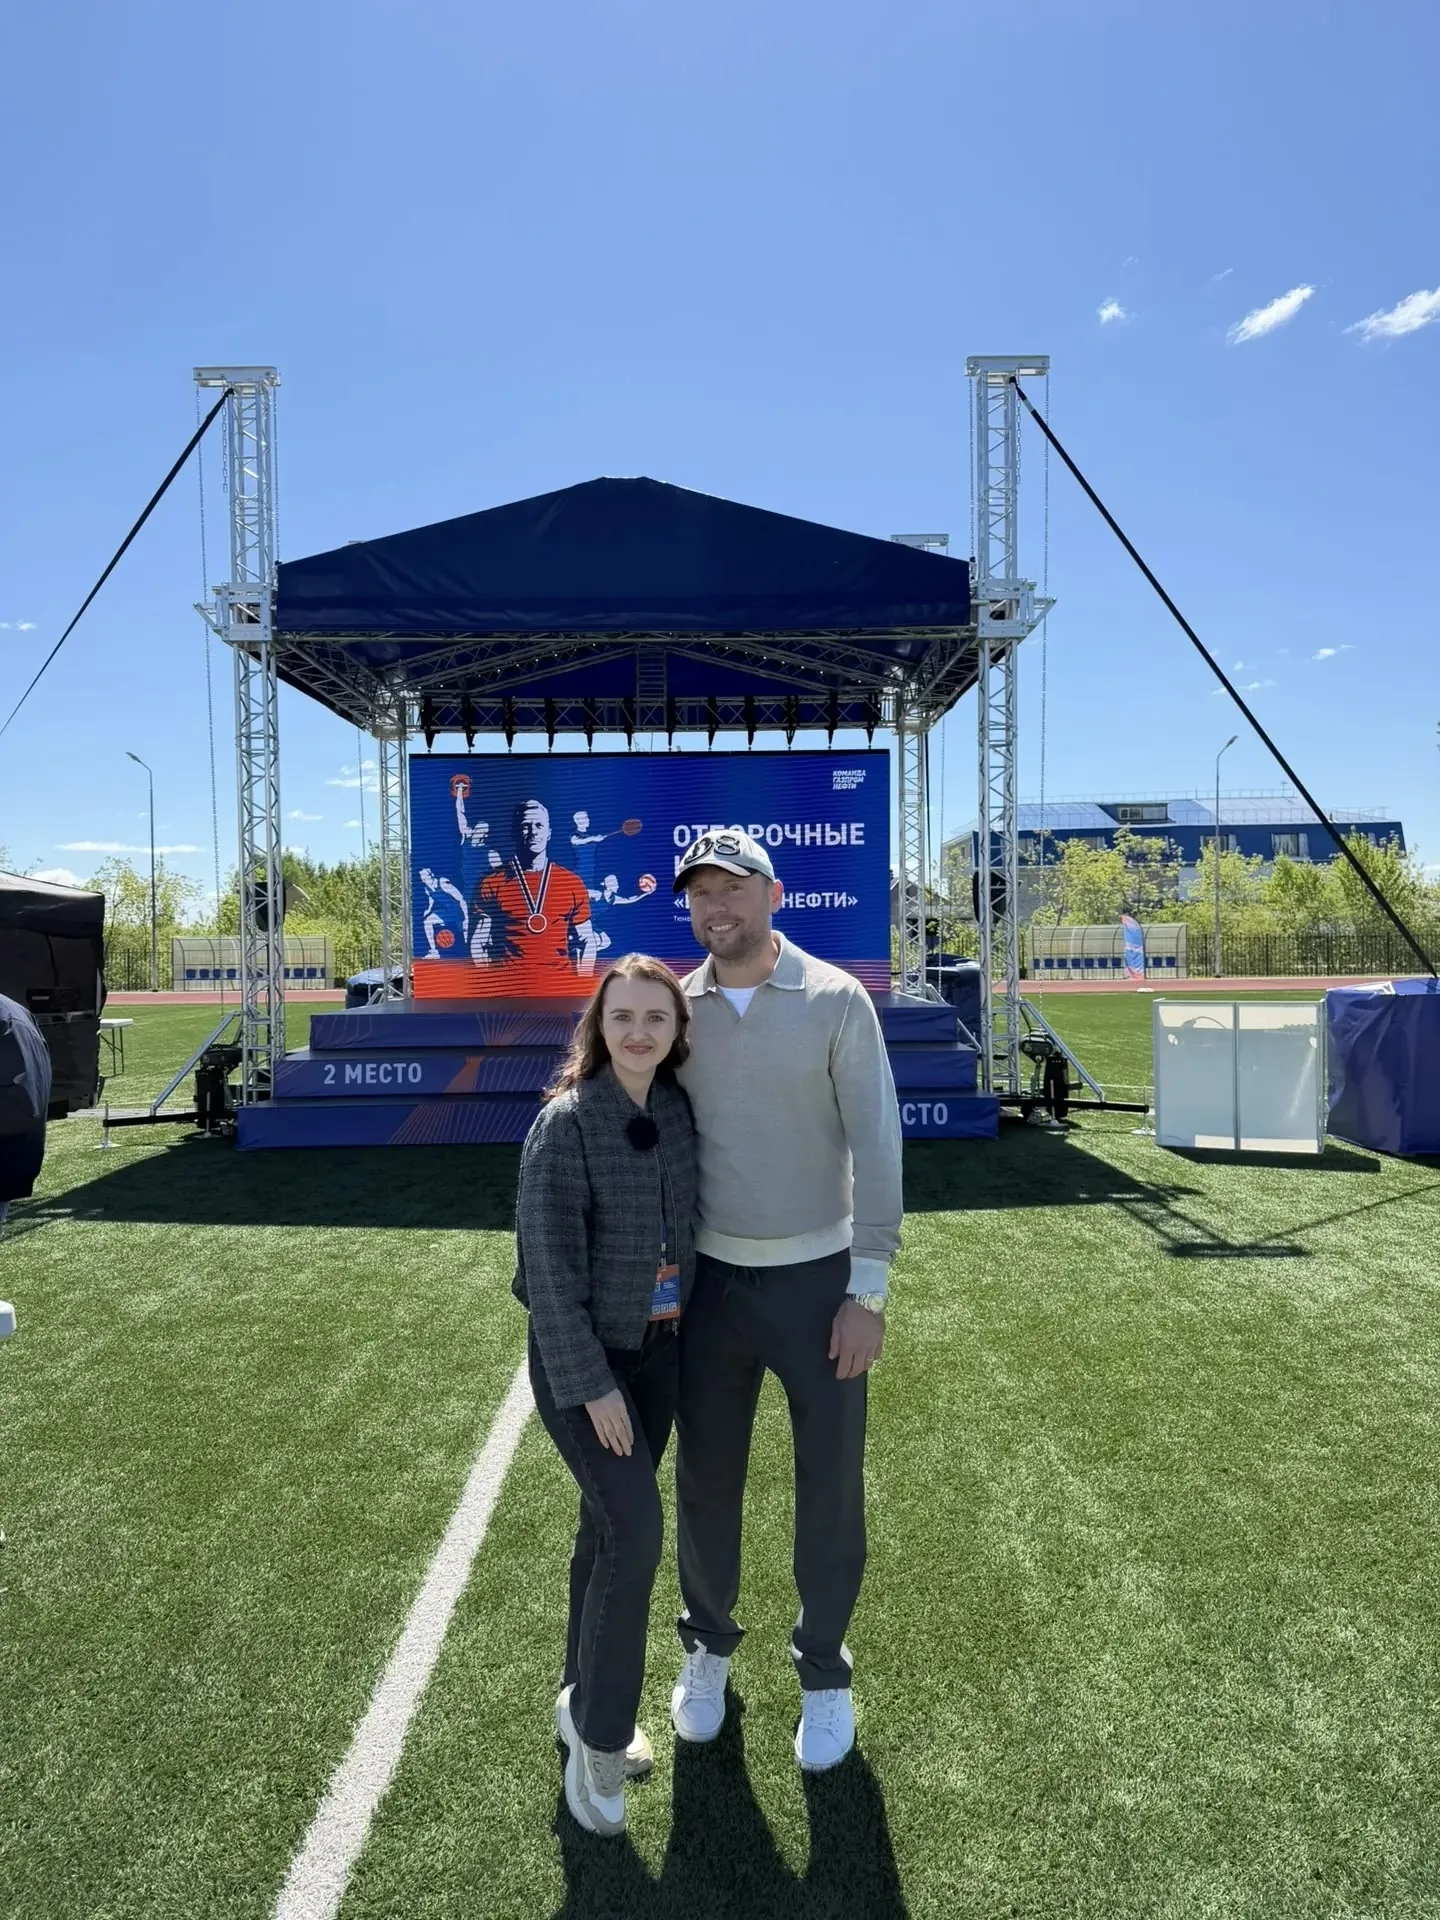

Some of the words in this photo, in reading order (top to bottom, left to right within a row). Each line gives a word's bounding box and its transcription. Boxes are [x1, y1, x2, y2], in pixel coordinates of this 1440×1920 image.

[832, 769, 867, 777] КОМАНДА
[673, 823, 865, 847] ОТРОЧНЫЕ
[323, 1064, 336, 1085] 2
[344, 1062, 423, 1085] МЕСТО
[901, 1102, 949, 1126] СТО
